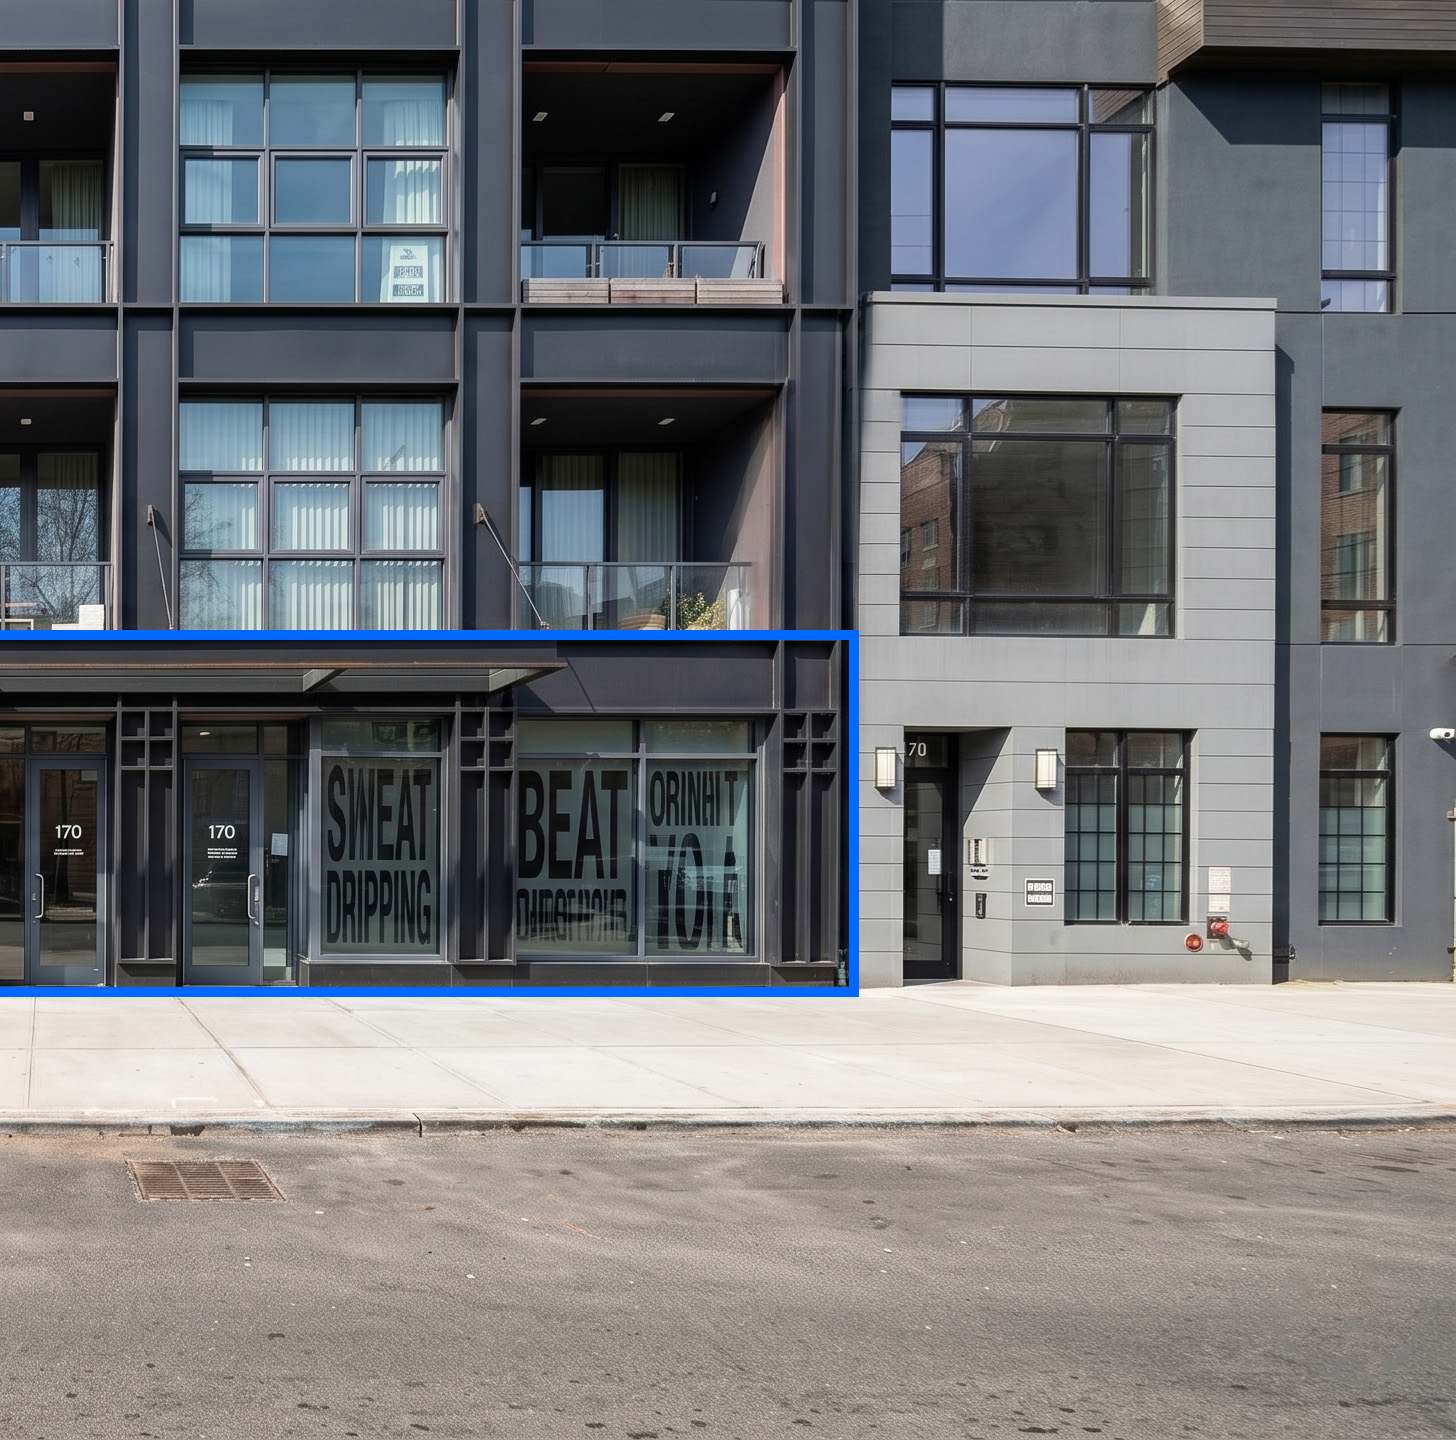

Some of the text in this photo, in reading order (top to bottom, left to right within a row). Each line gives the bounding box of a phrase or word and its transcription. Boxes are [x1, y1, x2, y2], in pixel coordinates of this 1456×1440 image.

[908, 742, 927, 757] 70
[55, 824, 82, 839] 170
[208, 824, 236, 839] 170
[327, 764, 432, 862] SWEAT
[518, 770, 628, 879] BEAT
[327, 869, 432, 945] DRIPPING
